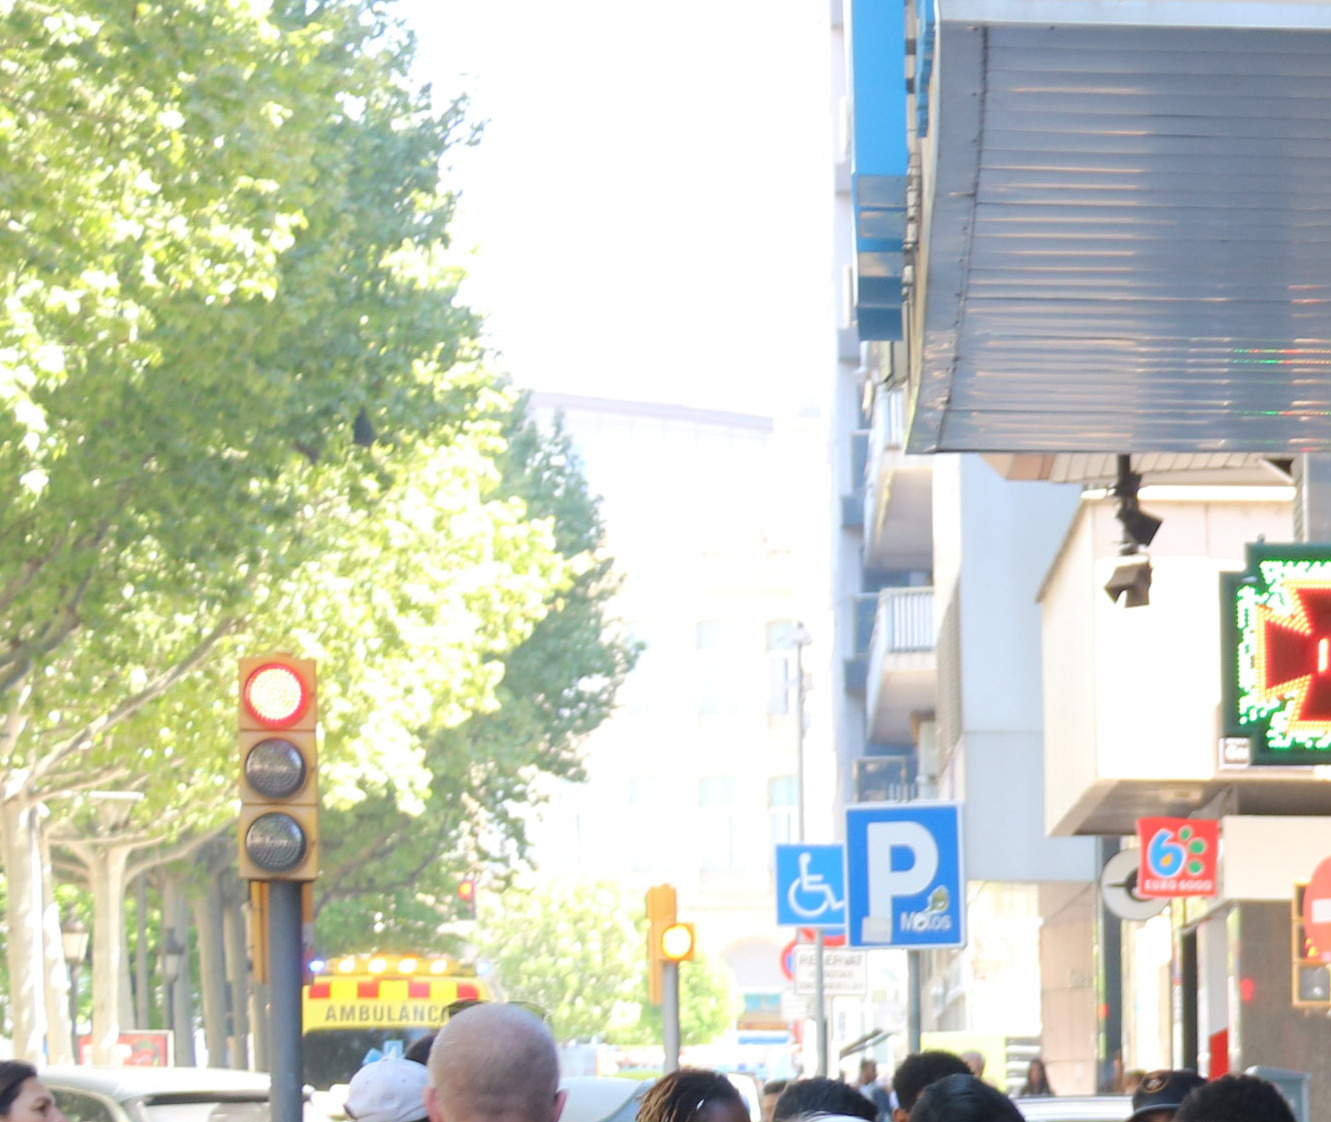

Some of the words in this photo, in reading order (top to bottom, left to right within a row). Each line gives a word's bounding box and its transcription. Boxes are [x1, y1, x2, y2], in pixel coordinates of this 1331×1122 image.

[866, 820, 939, 925] P
[1144, 879, 1177, 891] EURO
[1178, 879, 1213, 891] 6000
[324, 1004, 449, 1023] AMBULANC
